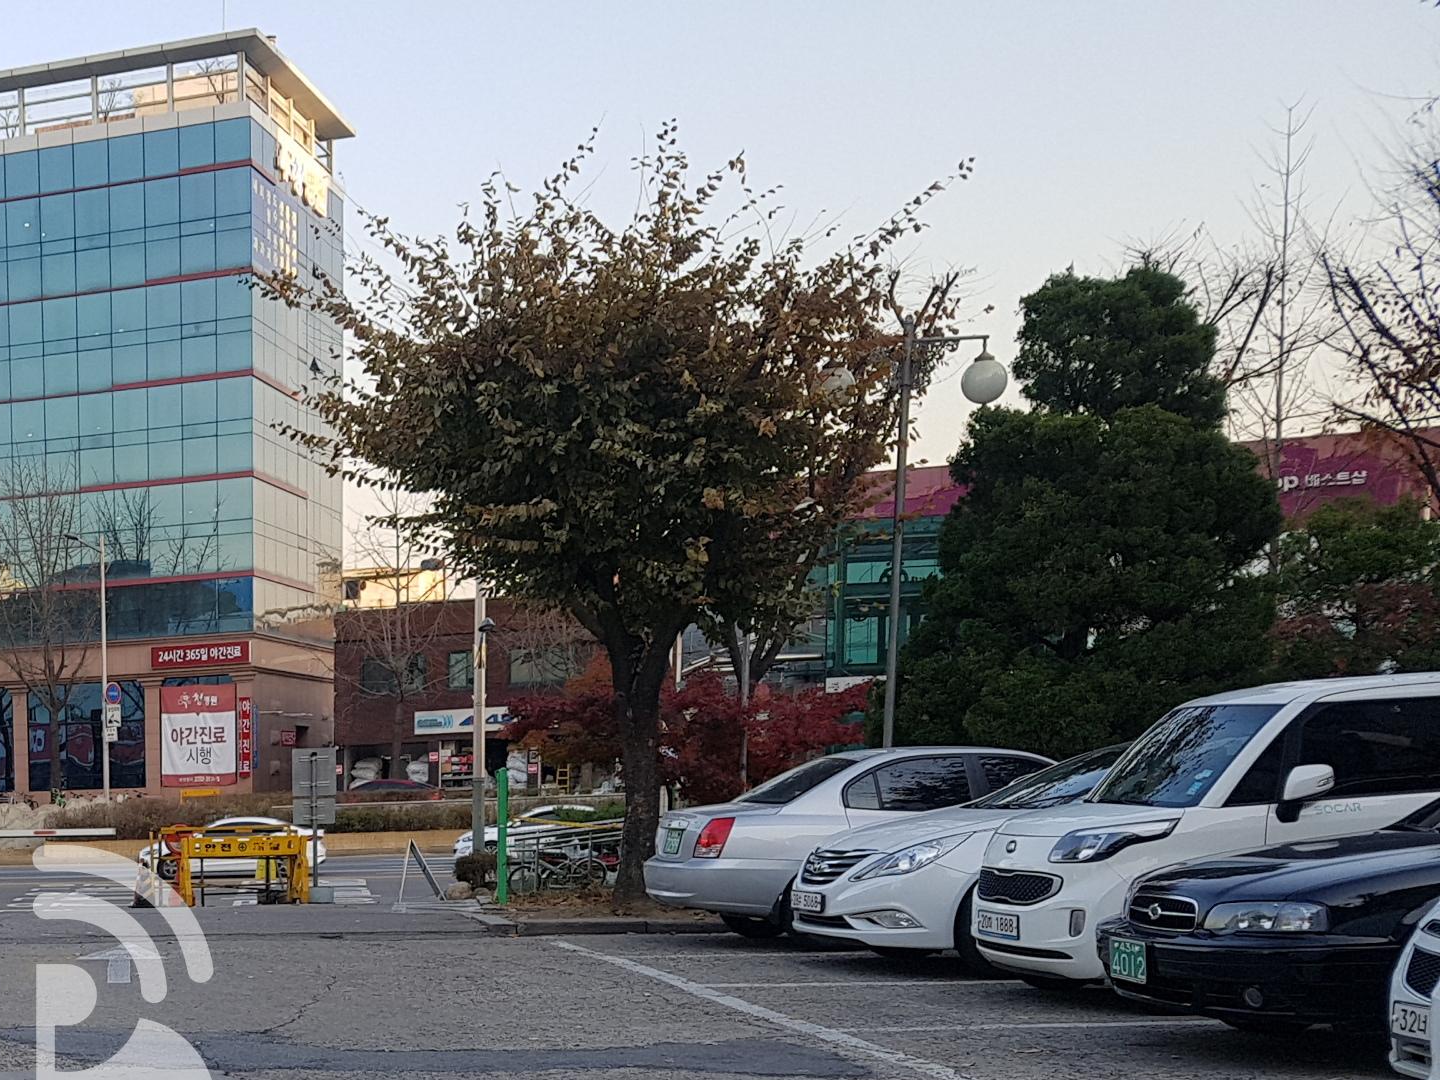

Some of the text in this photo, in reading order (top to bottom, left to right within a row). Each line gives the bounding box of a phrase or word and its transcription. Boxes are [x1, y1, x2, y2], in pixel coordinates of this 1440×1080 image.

[158, 645, 241, 662] 24시간 365일 야간진료
[171, 726, 227, 746] 야간진료
[186, 747, 213, 764] 시행
[1314, 802, 1362, 815] SOCAR
[1112, 952, 1145, 979] 4012
[1400, 1008, 1428, 1034] 32너
